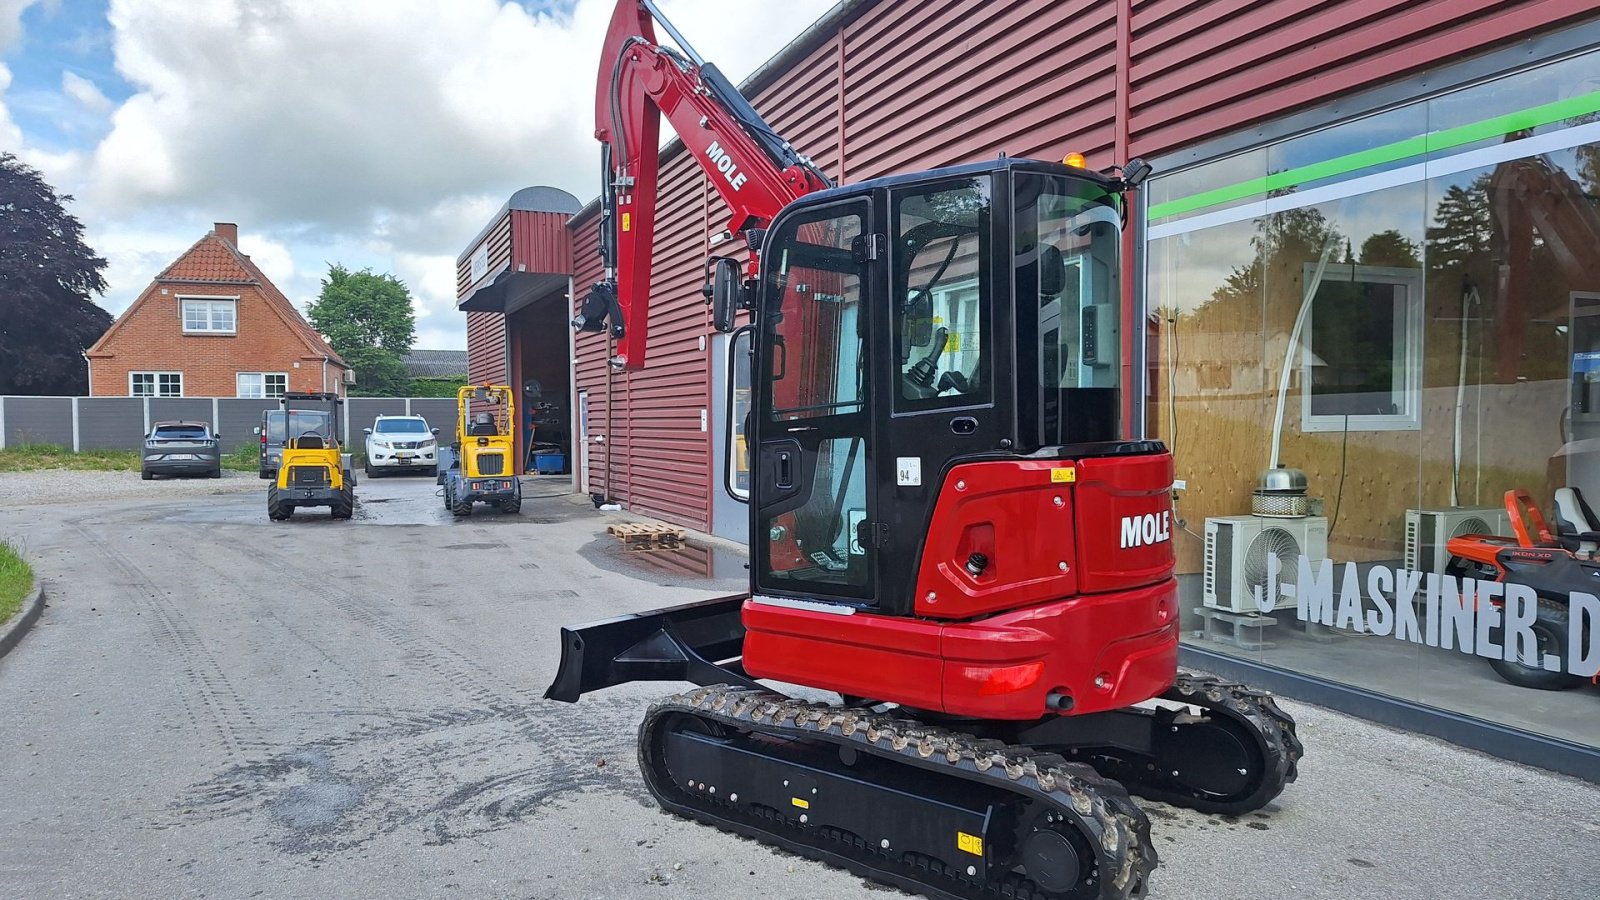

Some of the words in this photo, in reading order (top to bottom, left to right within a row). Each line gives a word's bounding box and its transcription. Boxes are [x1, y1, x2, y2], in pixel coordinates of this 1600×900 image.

[705, 141, 748, 192] MOLE
[900, 470, 909, 481] 94
[1120, 510, 1170, 549] MOLE
[1254, 552, 1600, 677] J-MASKINER.D
